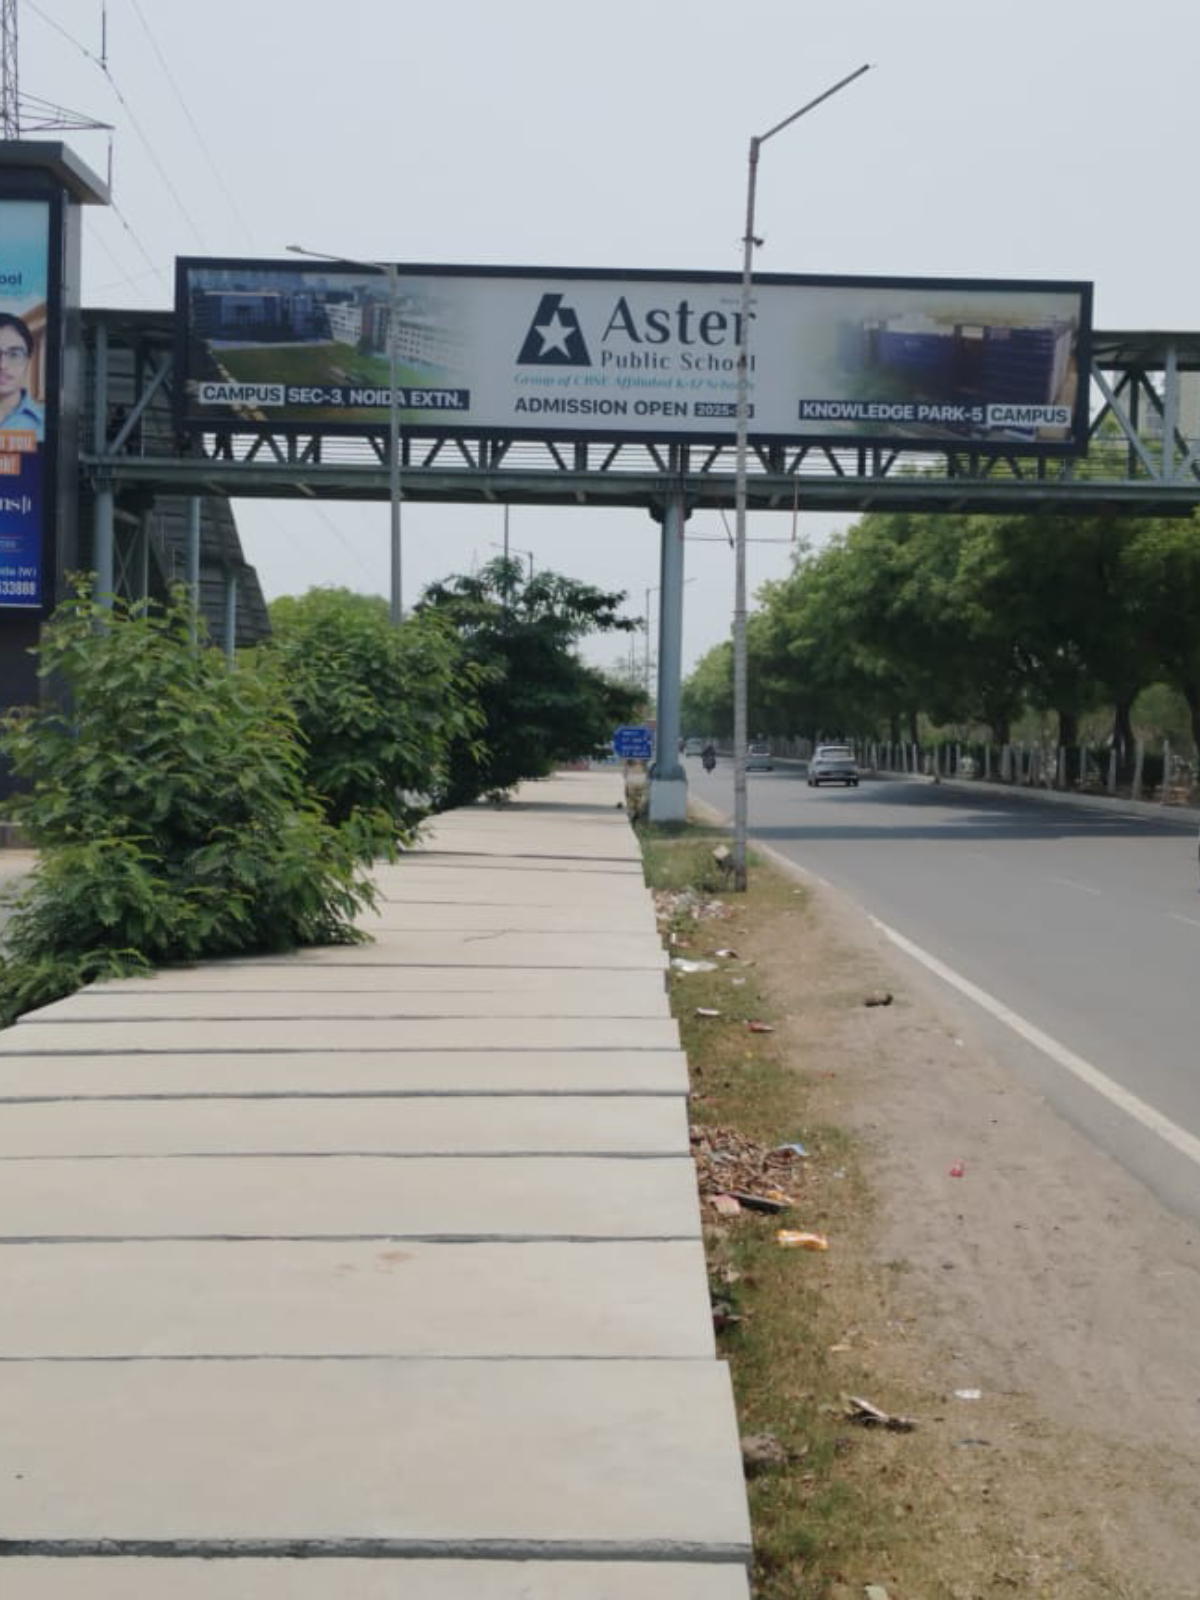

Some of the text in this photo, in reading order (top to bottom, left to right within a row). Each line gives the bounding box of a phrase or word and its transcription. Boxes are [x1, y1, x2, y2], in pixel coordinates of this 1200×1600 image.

[602, 295, 757, 346] Aster
[601, 350, 756, 371] Public Schol
[203, 385, 281, 402] CAMPUS
[411, 391, 464, 407] EXTN.
[515, 397, 628, 415] ADMISSION
[634, 400, 688, 416] OPEN
[803, 402, 1068, 424] KNOWLEDGE PARK-5 CAMPUS
